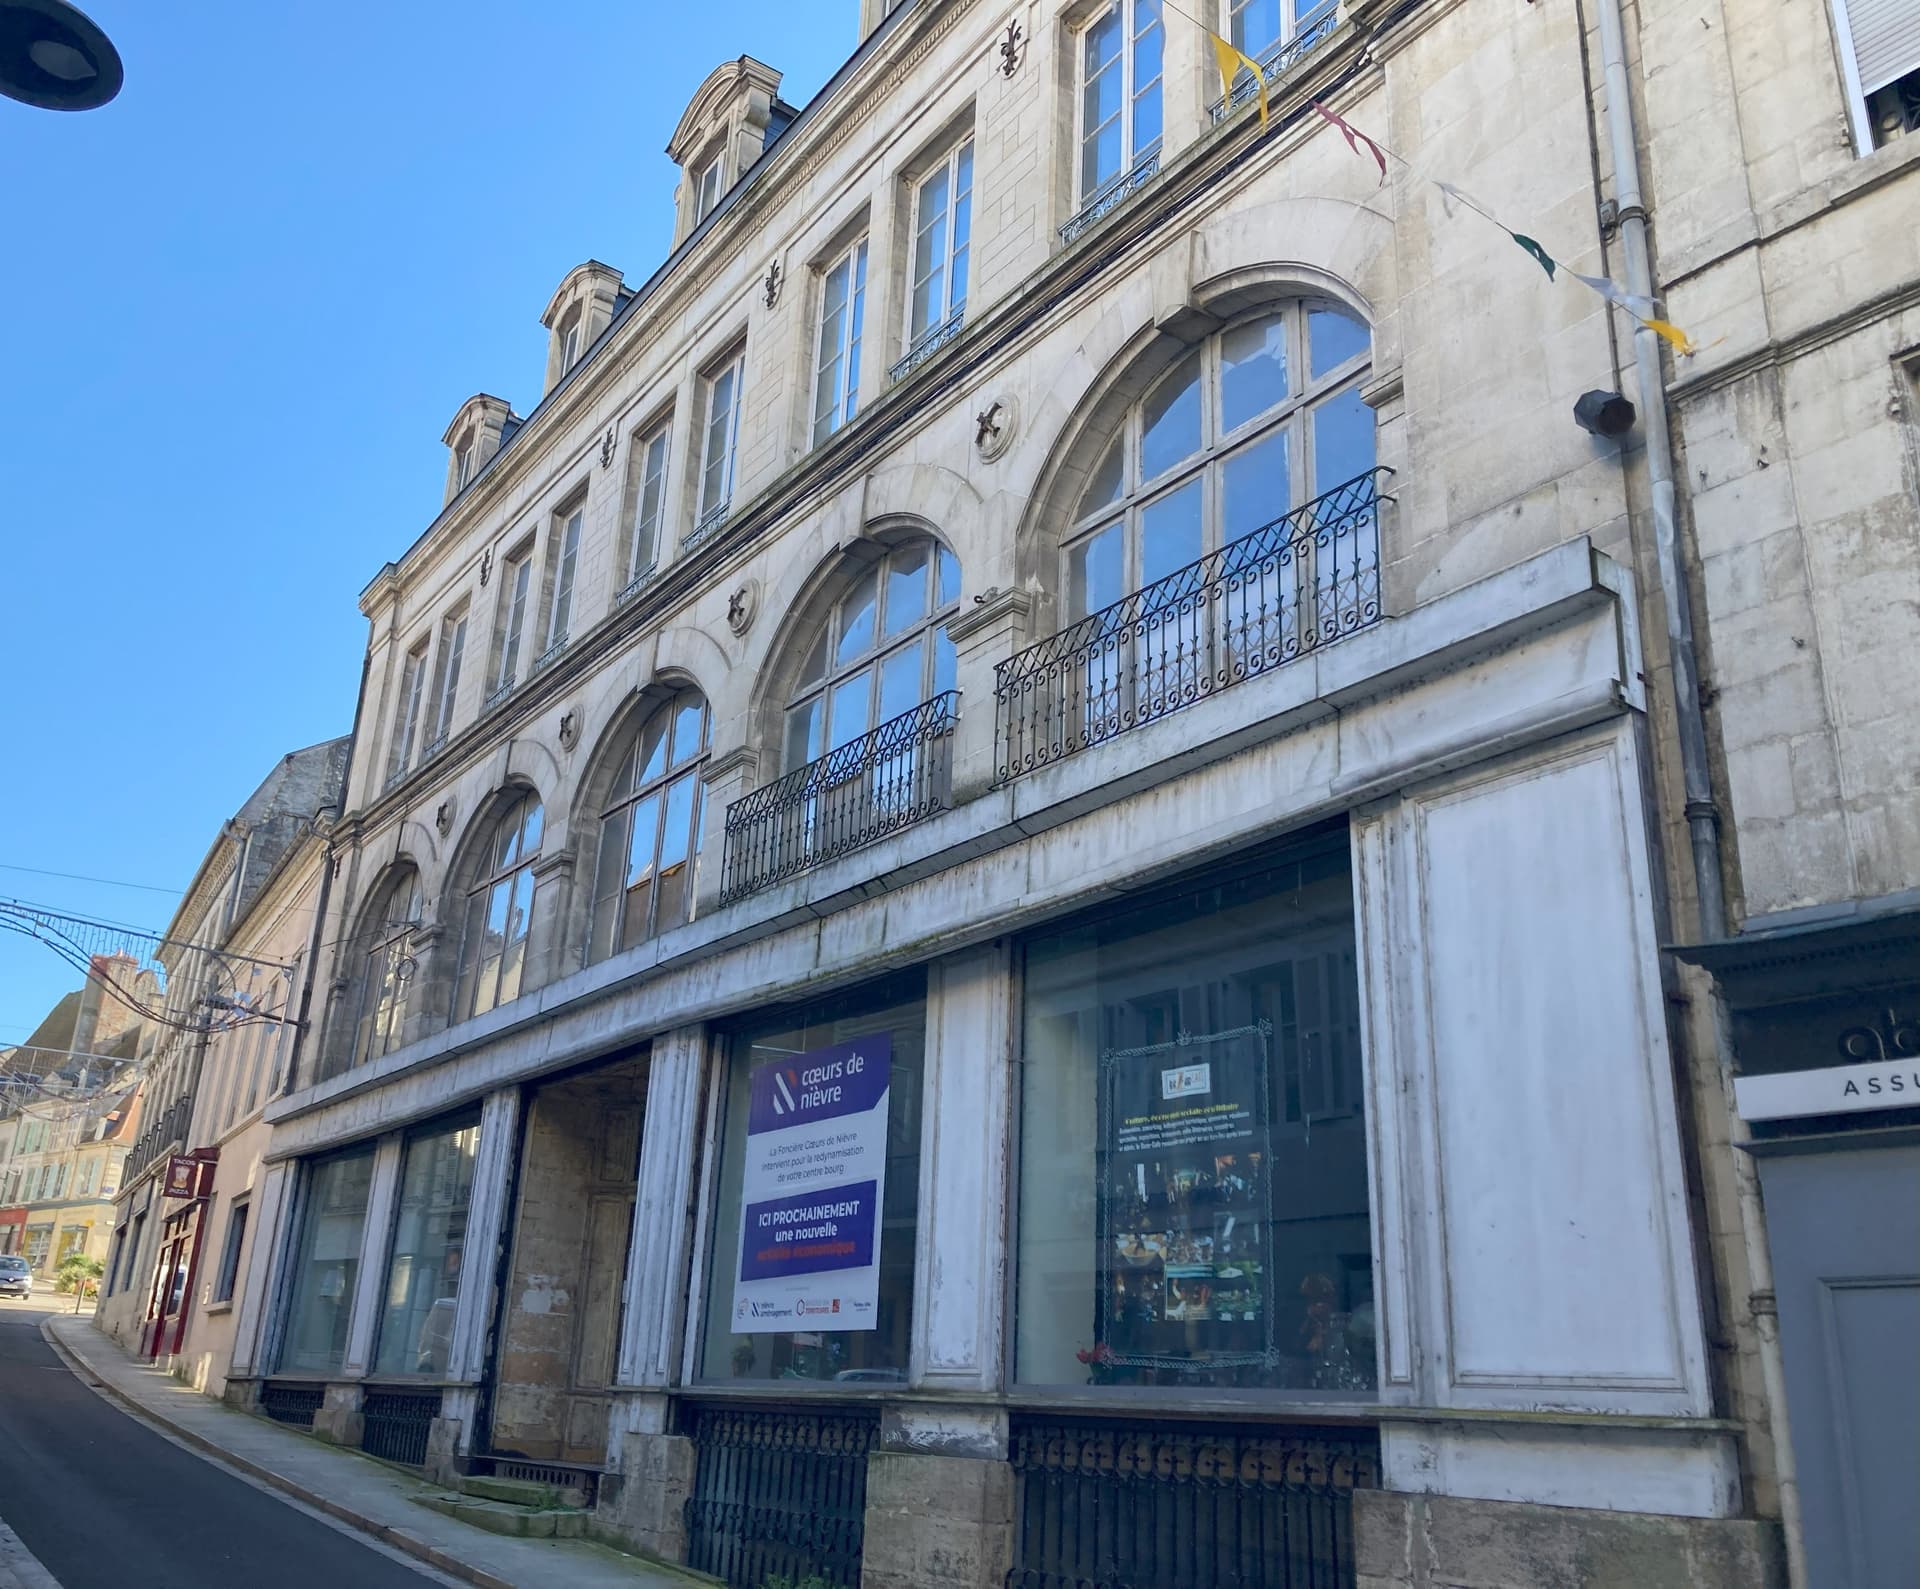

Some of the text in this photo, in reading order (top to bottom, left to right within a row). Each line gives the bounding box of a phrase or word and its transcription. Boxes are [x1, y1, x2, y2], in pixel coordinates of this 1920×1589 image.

[801, 1052, 865, 1087] cœurs de
[800, 1085, 842, 1110] nièvre
[826, 1136, 835, 1146] de
[777, 1163, 845, 1183] de votre centre bourg
[791, 1156, 805, 1170] pour
[759, 1200, 860, 1228] ICI PROCHAINEMENT
[775, 1221, 838, 1242] une nouvelle
